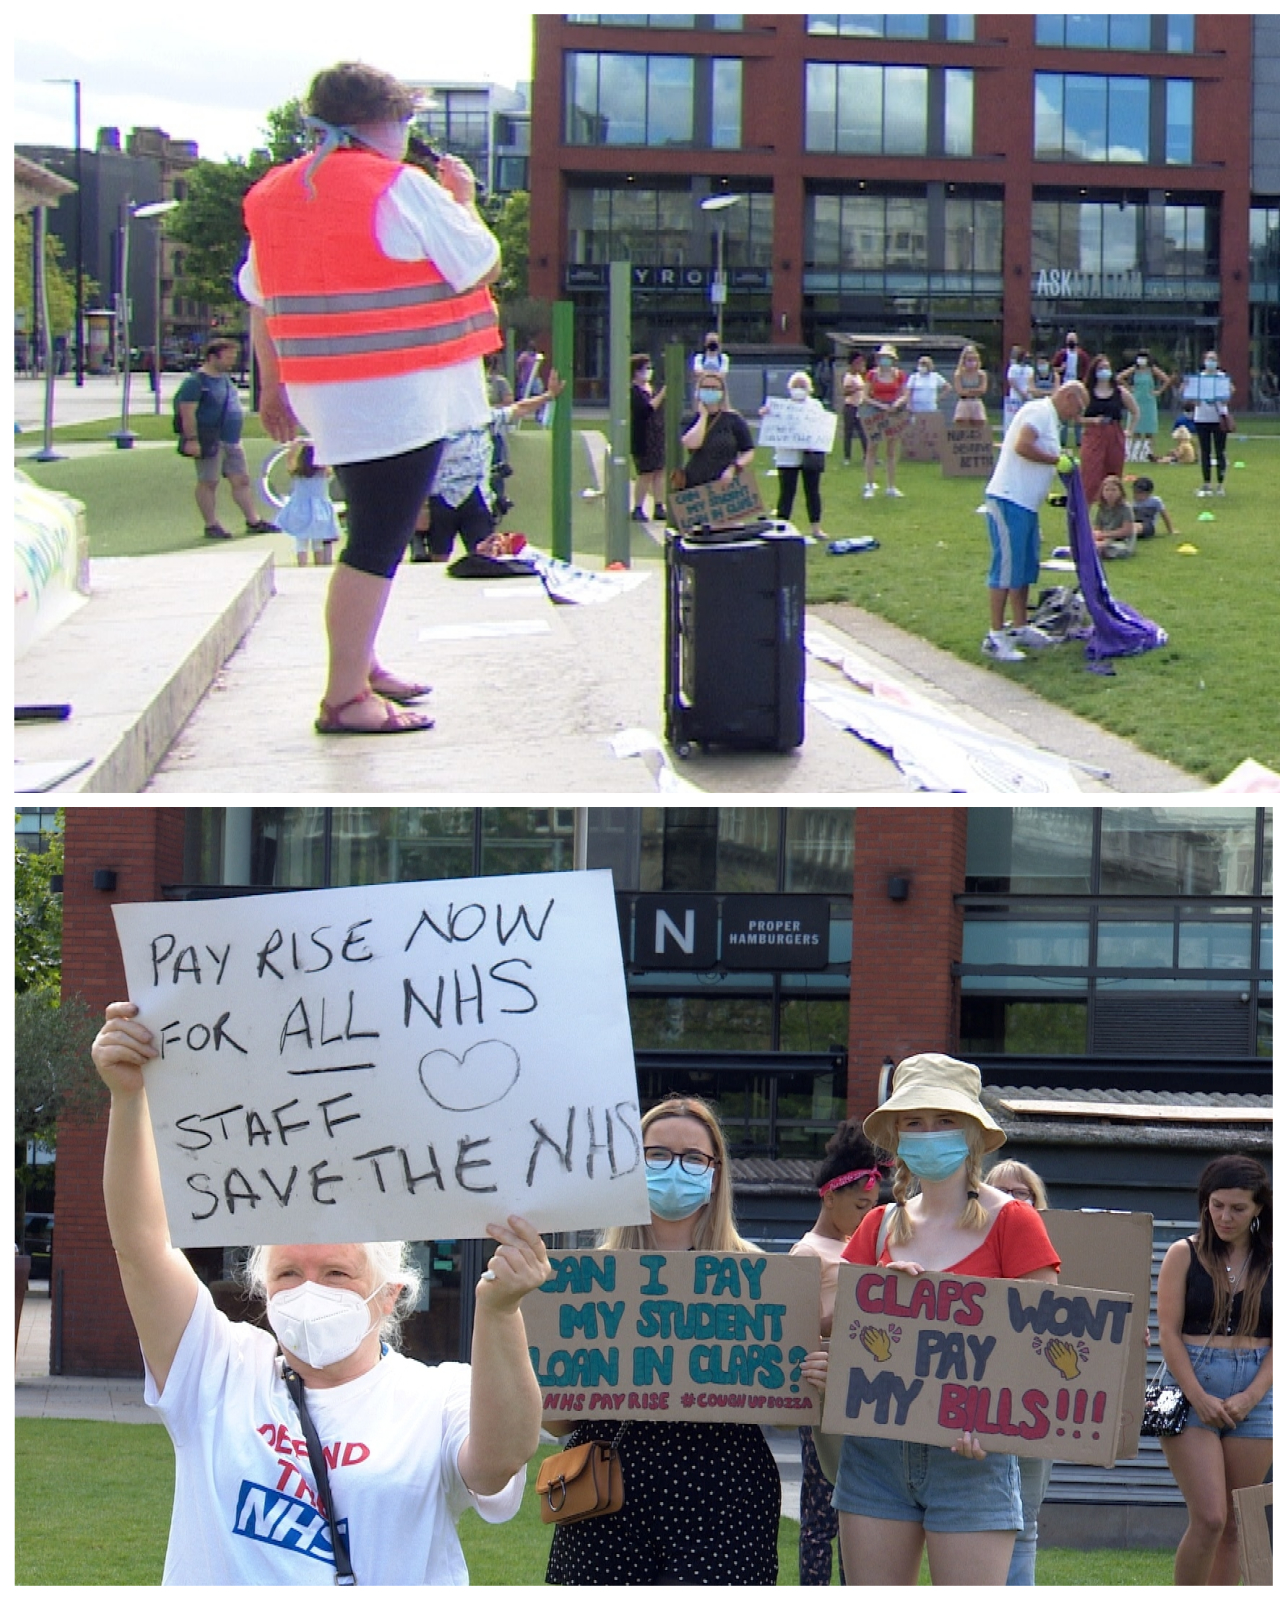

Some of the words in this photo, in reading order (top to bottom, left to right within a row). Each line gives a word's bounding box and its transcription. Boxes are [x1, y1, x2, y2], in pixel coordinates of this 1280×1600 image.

[1037, 268, 1072, 297] ASK
[150, 933, 231, 987] PAY
[257, 919, 375, 981] RISE
[405, 898, 554, 952] NOW
[729, 934, 819, 945] HAMBURGERS
[748, 920, 800, 932] PROPER
[160, 1011, 248, 1059] FOR
[280, 990, 379, 1054] ALL
[403, 957, 539, 1029] NHS
[175, 1092, 361, 1151] STAFF
[187, 1160, 343, 1221] SAVE
[353, 1136, 498, 1195] THE
[526, 1101, 643, 1189] NHS
[539, 1255, 616, 1293] CAN
[639, 1255, 668, 1295] I
[694, 1255, 767, 1300] PAY
[559, 1301, 625, 1340] MY
[636, 1300, 787, 1342] STUDENT
[856, 1274, 986, 1326] CLAPS
[1008, 1287, 1133, 1344] WONT
[528, 1346, 619, 1387] LOAN
[632, 1346, 674, 1386] IN
[689, 1345, 809, 1393] CLAPS?
[915, 1330, 997, 1381] PAY
[543, 1393, 583, 1412] NHS
[588, 1393, 626, 1411] PAY
[627, 1392, 670, 1411] RISE
[845, 1367, 924, 1425] MY
[938, 1383, 1106, 1440] BILLS!!!
[257, 1424, 370, 1470] DEFND
